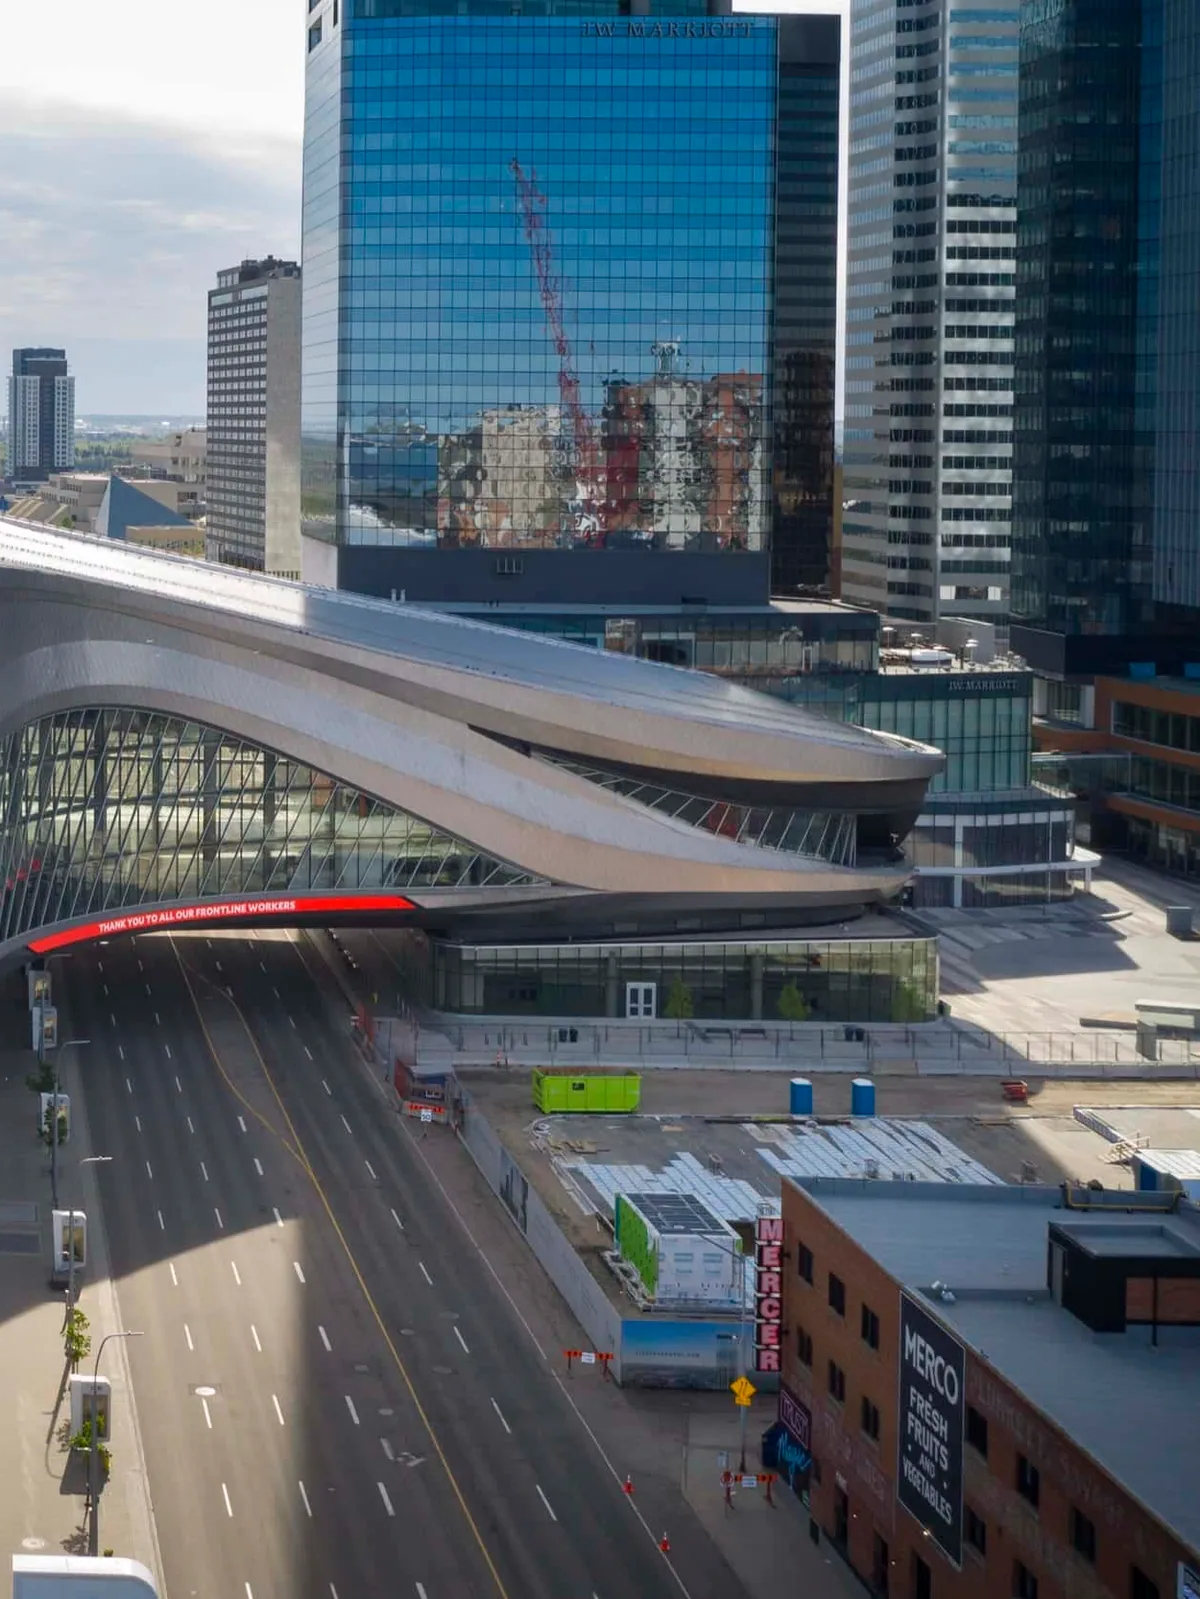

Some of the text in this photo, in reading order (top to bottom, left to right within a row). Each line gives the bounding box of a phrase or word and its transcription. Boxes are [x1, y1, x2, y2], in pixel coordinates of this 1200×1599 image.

[582, 21, 751, 38] JW MARRIOTT
[98, 900, 296, 933] THANK YOU TO ALL OUR FRONTLINE WORKERS
[759, 1219, 783, 1370] MERCER
[905, 1323, 959, 1405] MERCO
[907, 1411, 949, 1471] FRUITS
[910, 1385, 948, 1442] FRESH
[903, 1455, 952, 1525] VEGETABLES
[919, 1453, 936, 1478] AND
